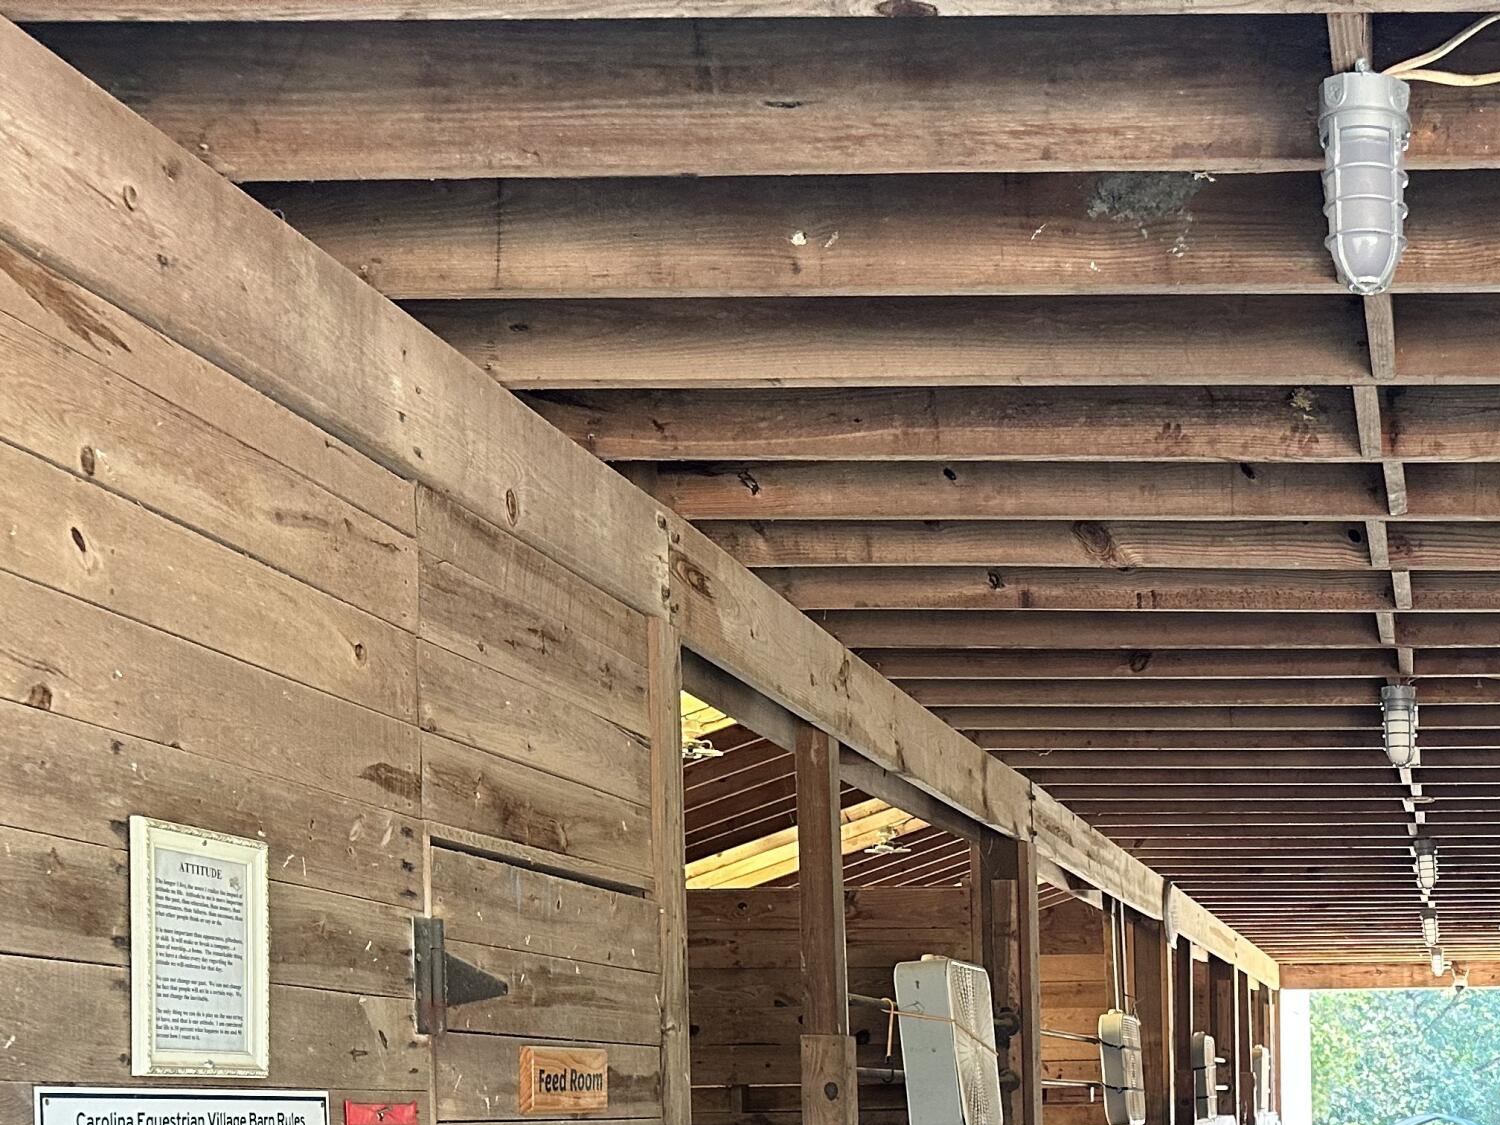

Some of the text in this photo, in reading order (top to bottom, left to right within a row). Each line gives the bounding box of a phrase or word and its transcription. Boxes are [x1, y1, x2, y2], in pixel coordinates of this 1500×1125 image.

[179, 862, 222, 879] ATTITUDE
[539, 1068, 602, 1092] Feed Room
